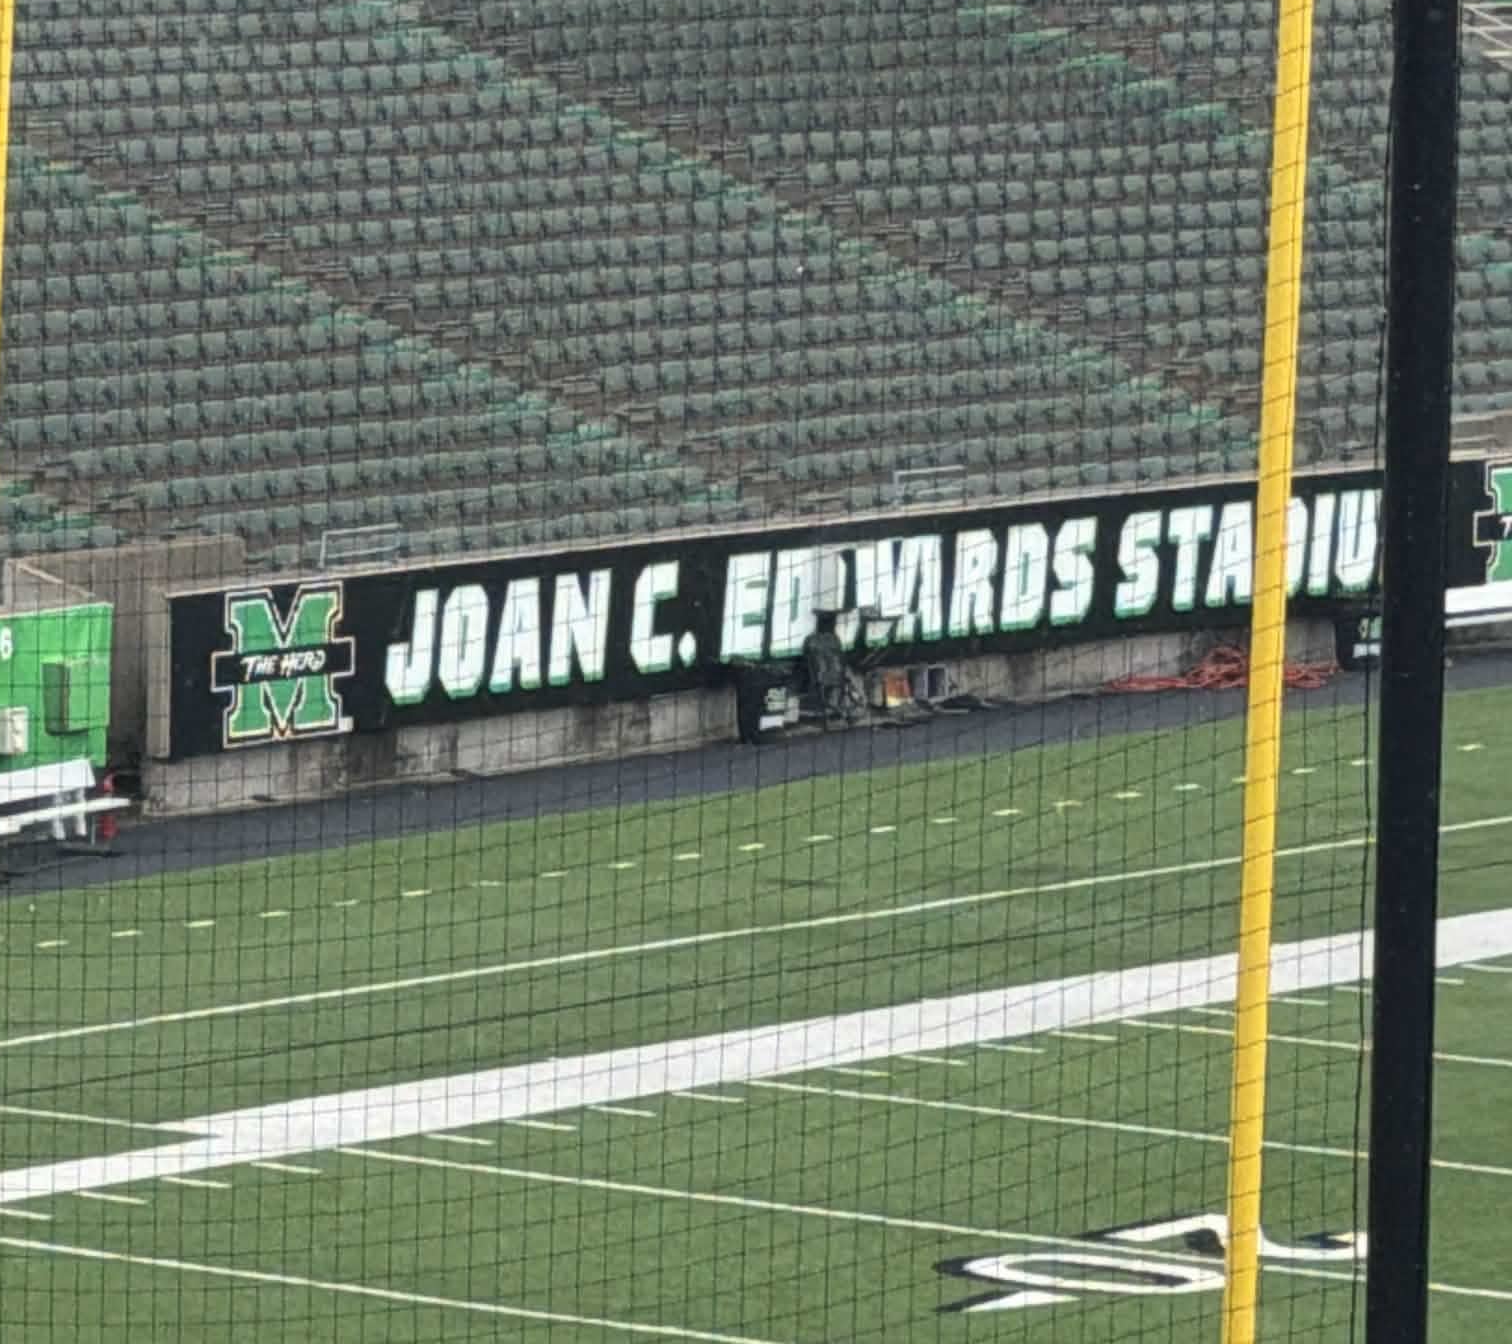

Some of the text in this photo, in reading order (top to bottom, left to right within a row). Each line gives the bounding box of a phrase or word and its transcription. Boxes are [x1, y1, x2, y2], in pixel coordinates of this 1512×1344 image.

[385, 489, 1383, 705] JOAN C. EDWARDS STAIU
[240, 655, 279, 682] THE
